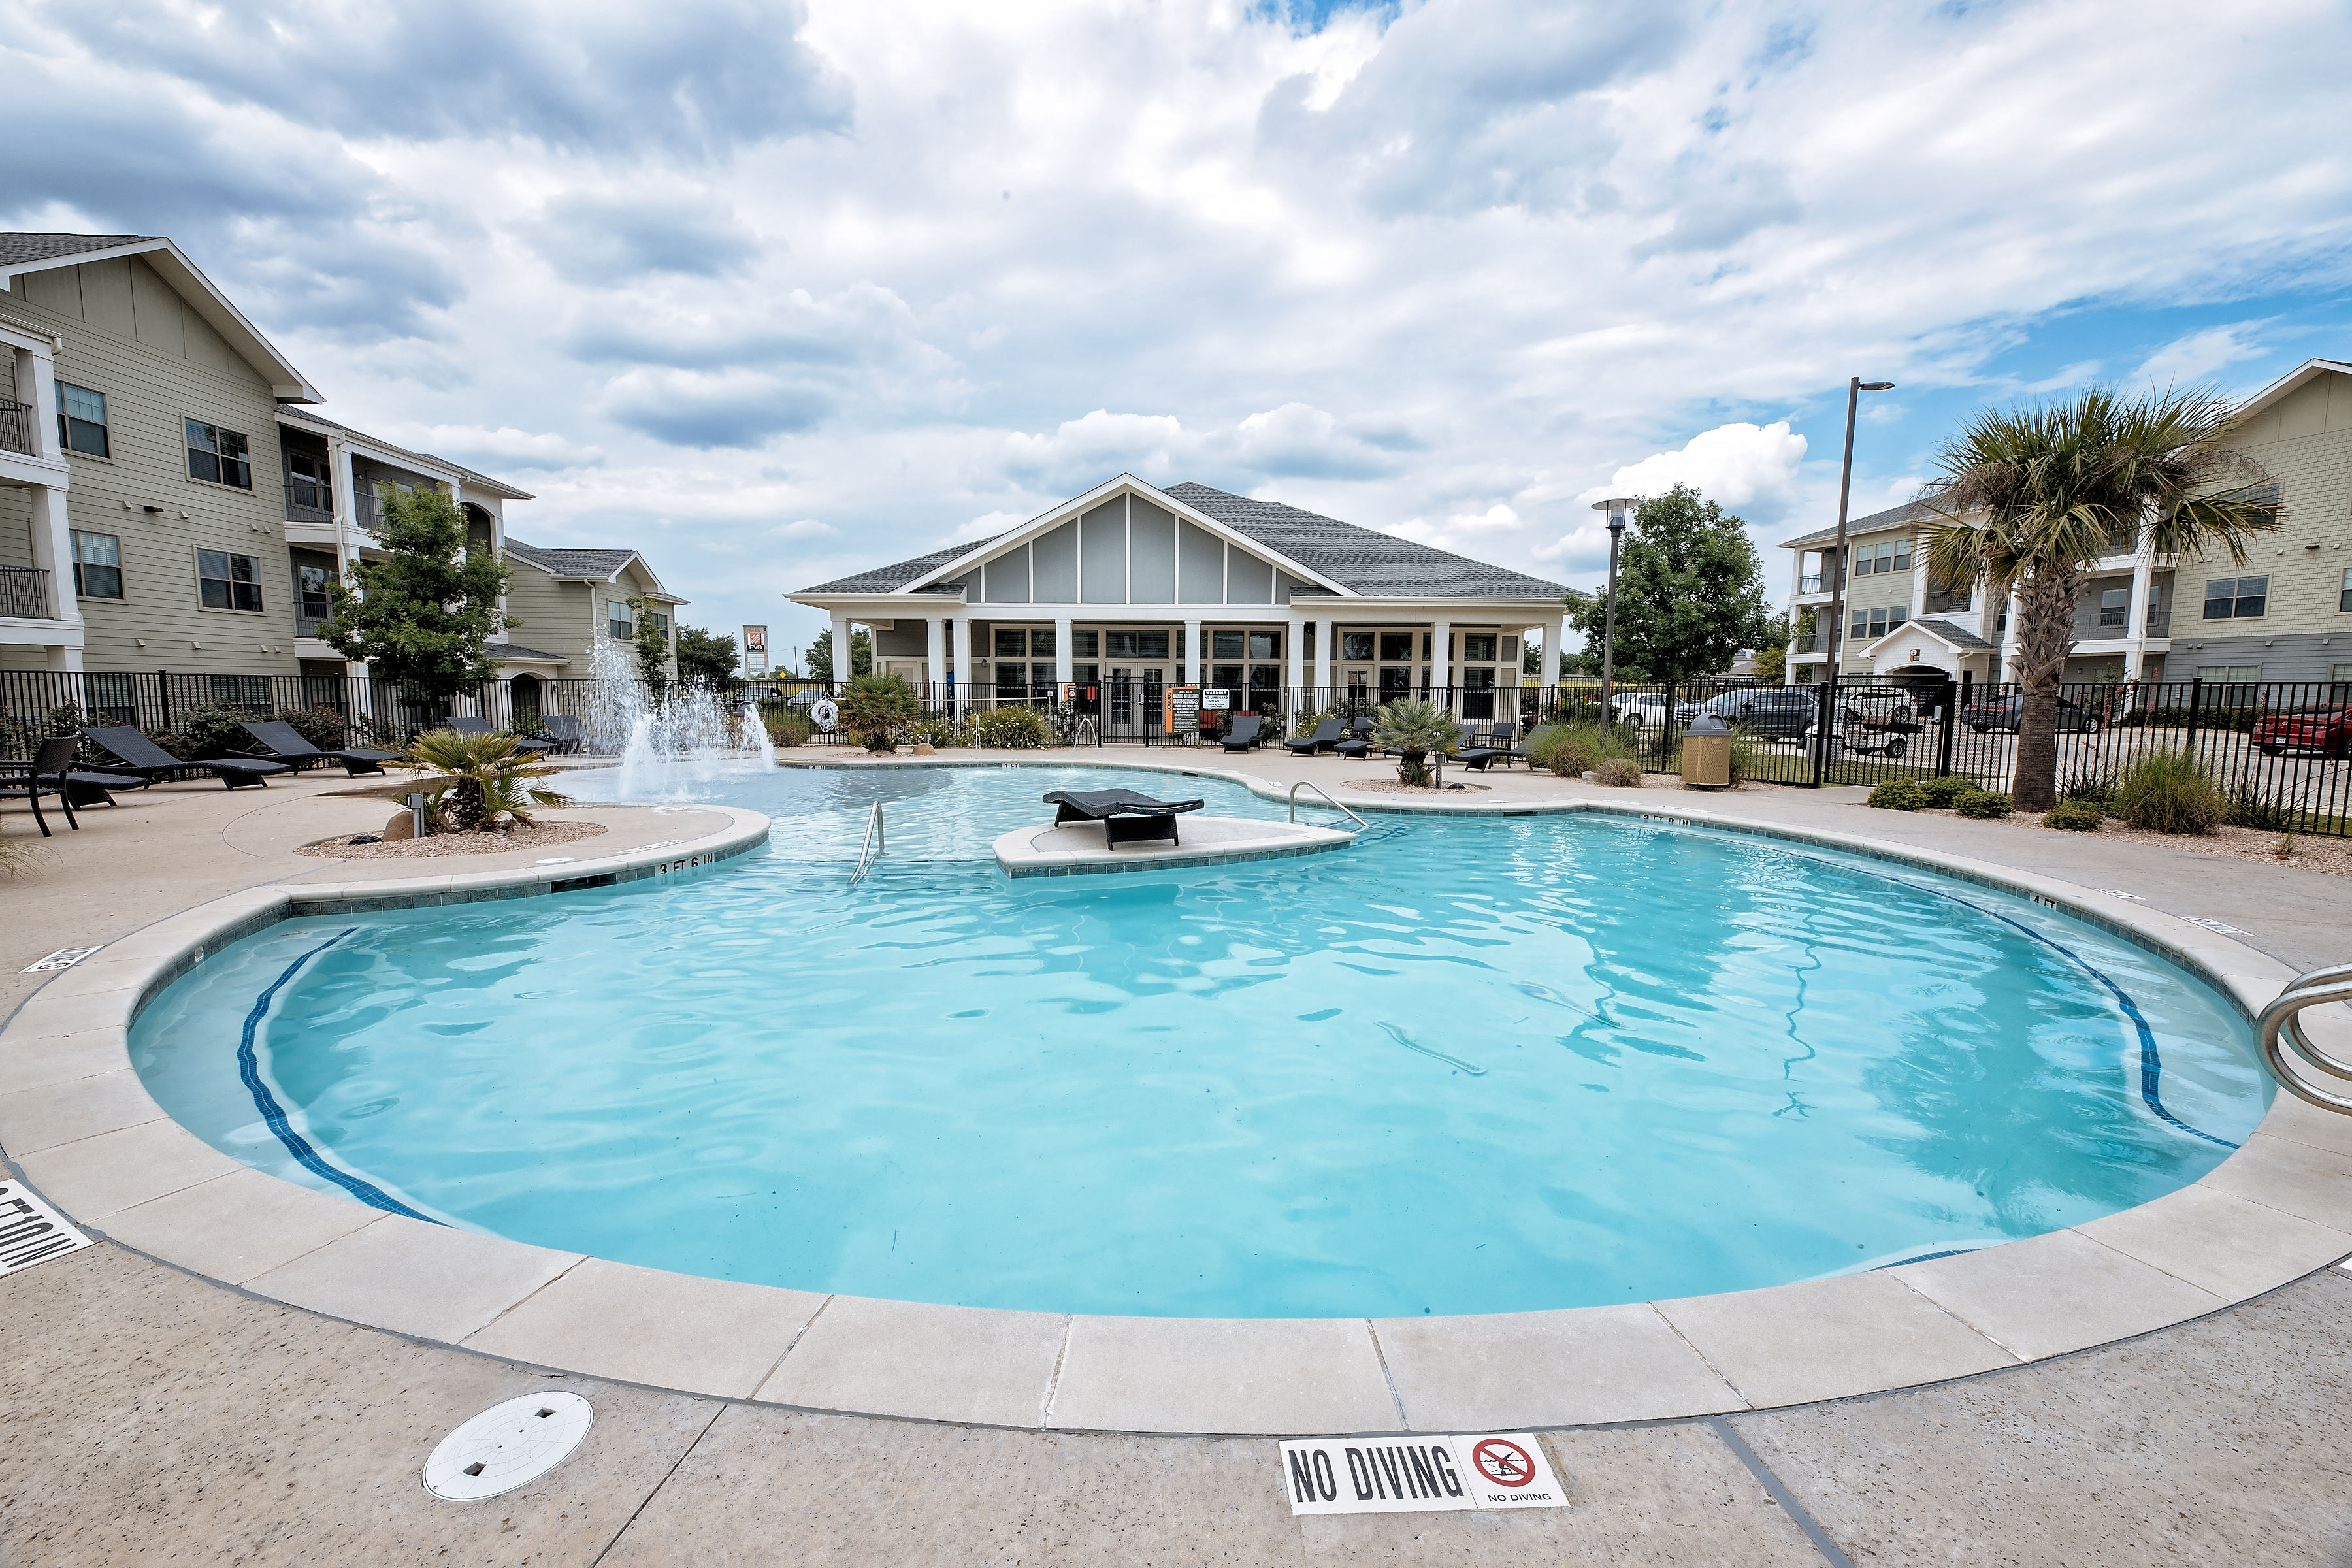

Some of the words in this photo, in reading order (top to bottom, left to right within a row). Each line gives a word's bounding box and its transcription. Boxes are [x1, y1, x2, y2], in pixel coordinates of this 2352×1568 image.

[660, 863, 667, 874] 3
[673, 859, 685, 871] FT
[691, 857, 698, 867] 6
[704, 853, 712, 864] IN
[2044, 898, 2055, 908] FT
[0, 1232, 78, 1268] IN
[1288, 1449, 1337, 1503] NO
[1345, 1445, 1464, 1500] DIVING
[1509, 1493, 1552, 1501] DIVING
